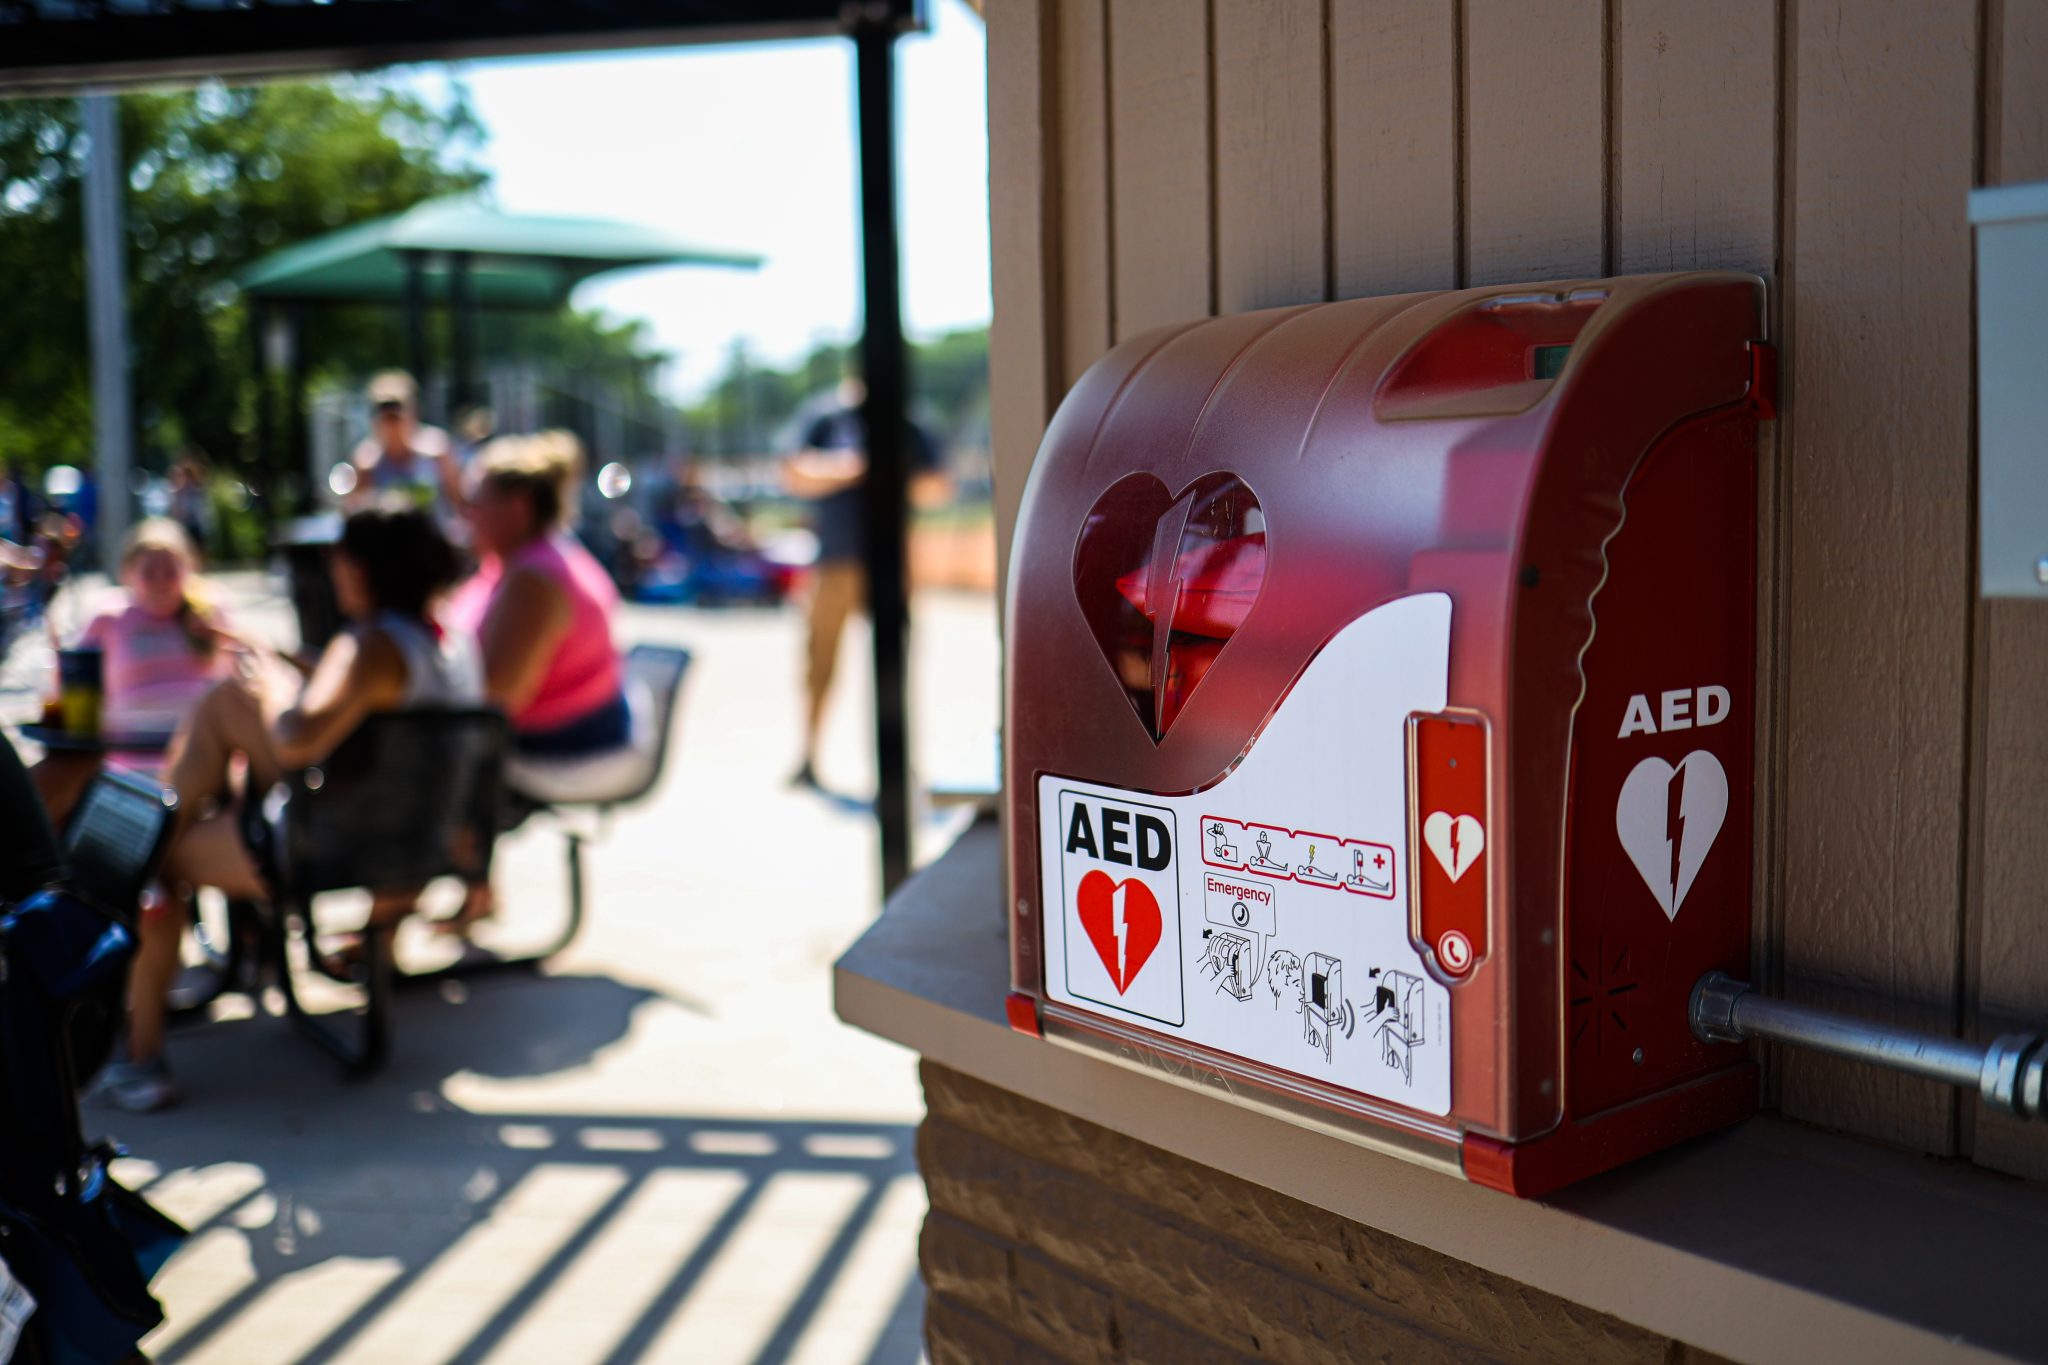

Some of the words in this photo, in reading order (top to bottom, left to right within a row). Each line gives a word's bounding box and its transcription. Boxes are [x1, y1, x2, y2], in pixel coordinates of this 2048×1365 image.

[1617, 685, 1731, 739] AED
[1066, 802, 1172, 872] AED
[1207, 877, 1271, 906] Emergency
